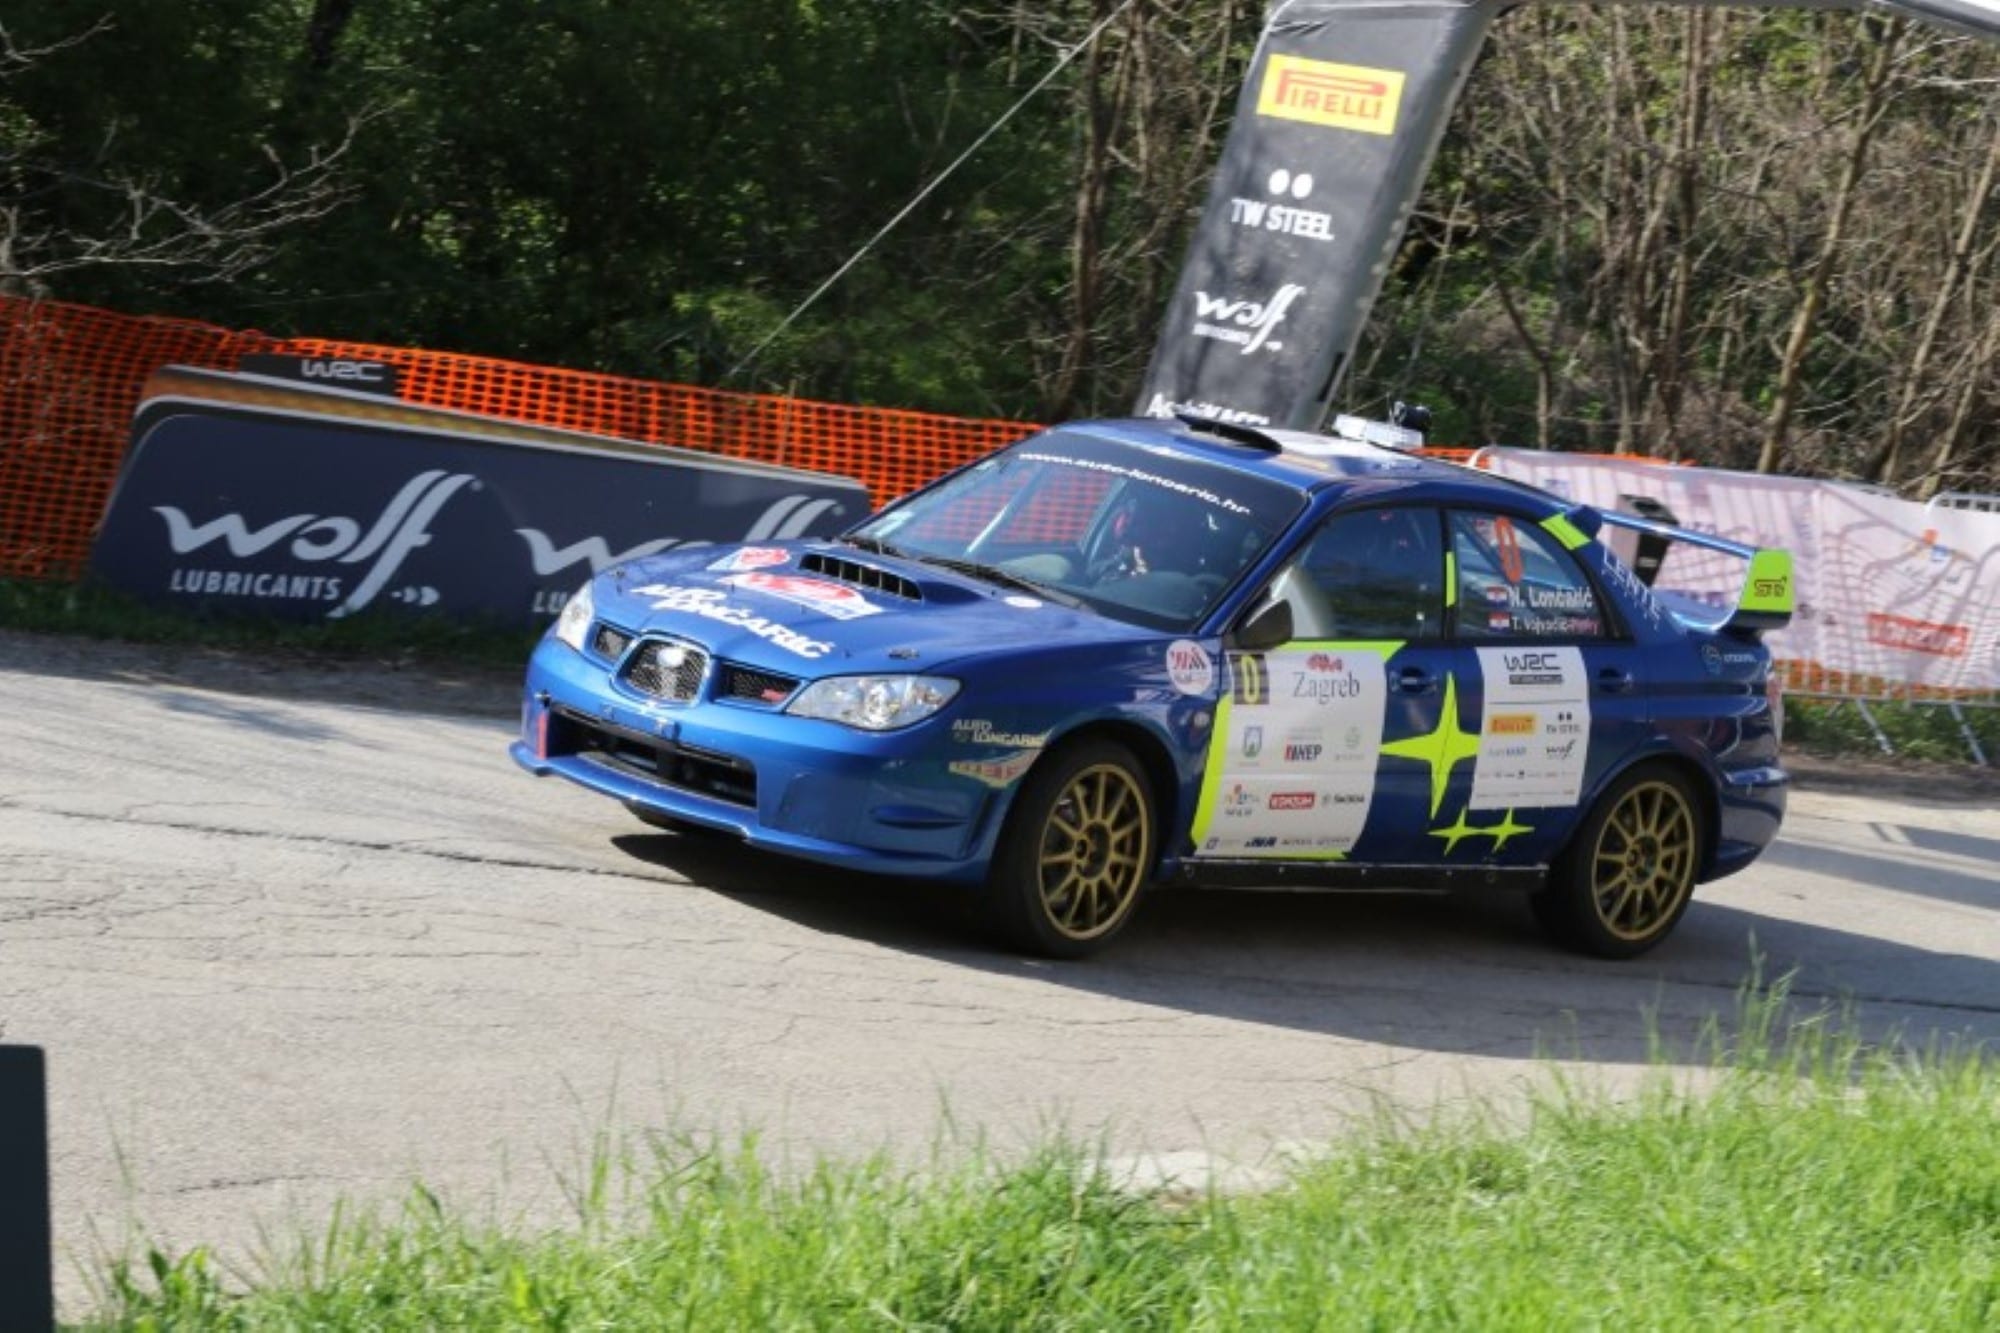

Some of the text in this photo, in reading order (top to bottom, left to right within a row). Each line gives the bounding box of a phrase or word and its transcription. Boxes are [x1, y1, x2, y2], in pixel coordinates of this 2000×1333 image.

[1275, 69, 1388, 119] PIRELLI
[1231, 197, 1335, 240] TW STEEL
[301, 358, 385, 381] WRC
[168, 568, 343, 600] LUBRICANTS
[1240, 655, 1261, 704] 0
[1503, 653, 1562, 672] WRC
[1293, 671, 1360, 705] Zagreb
